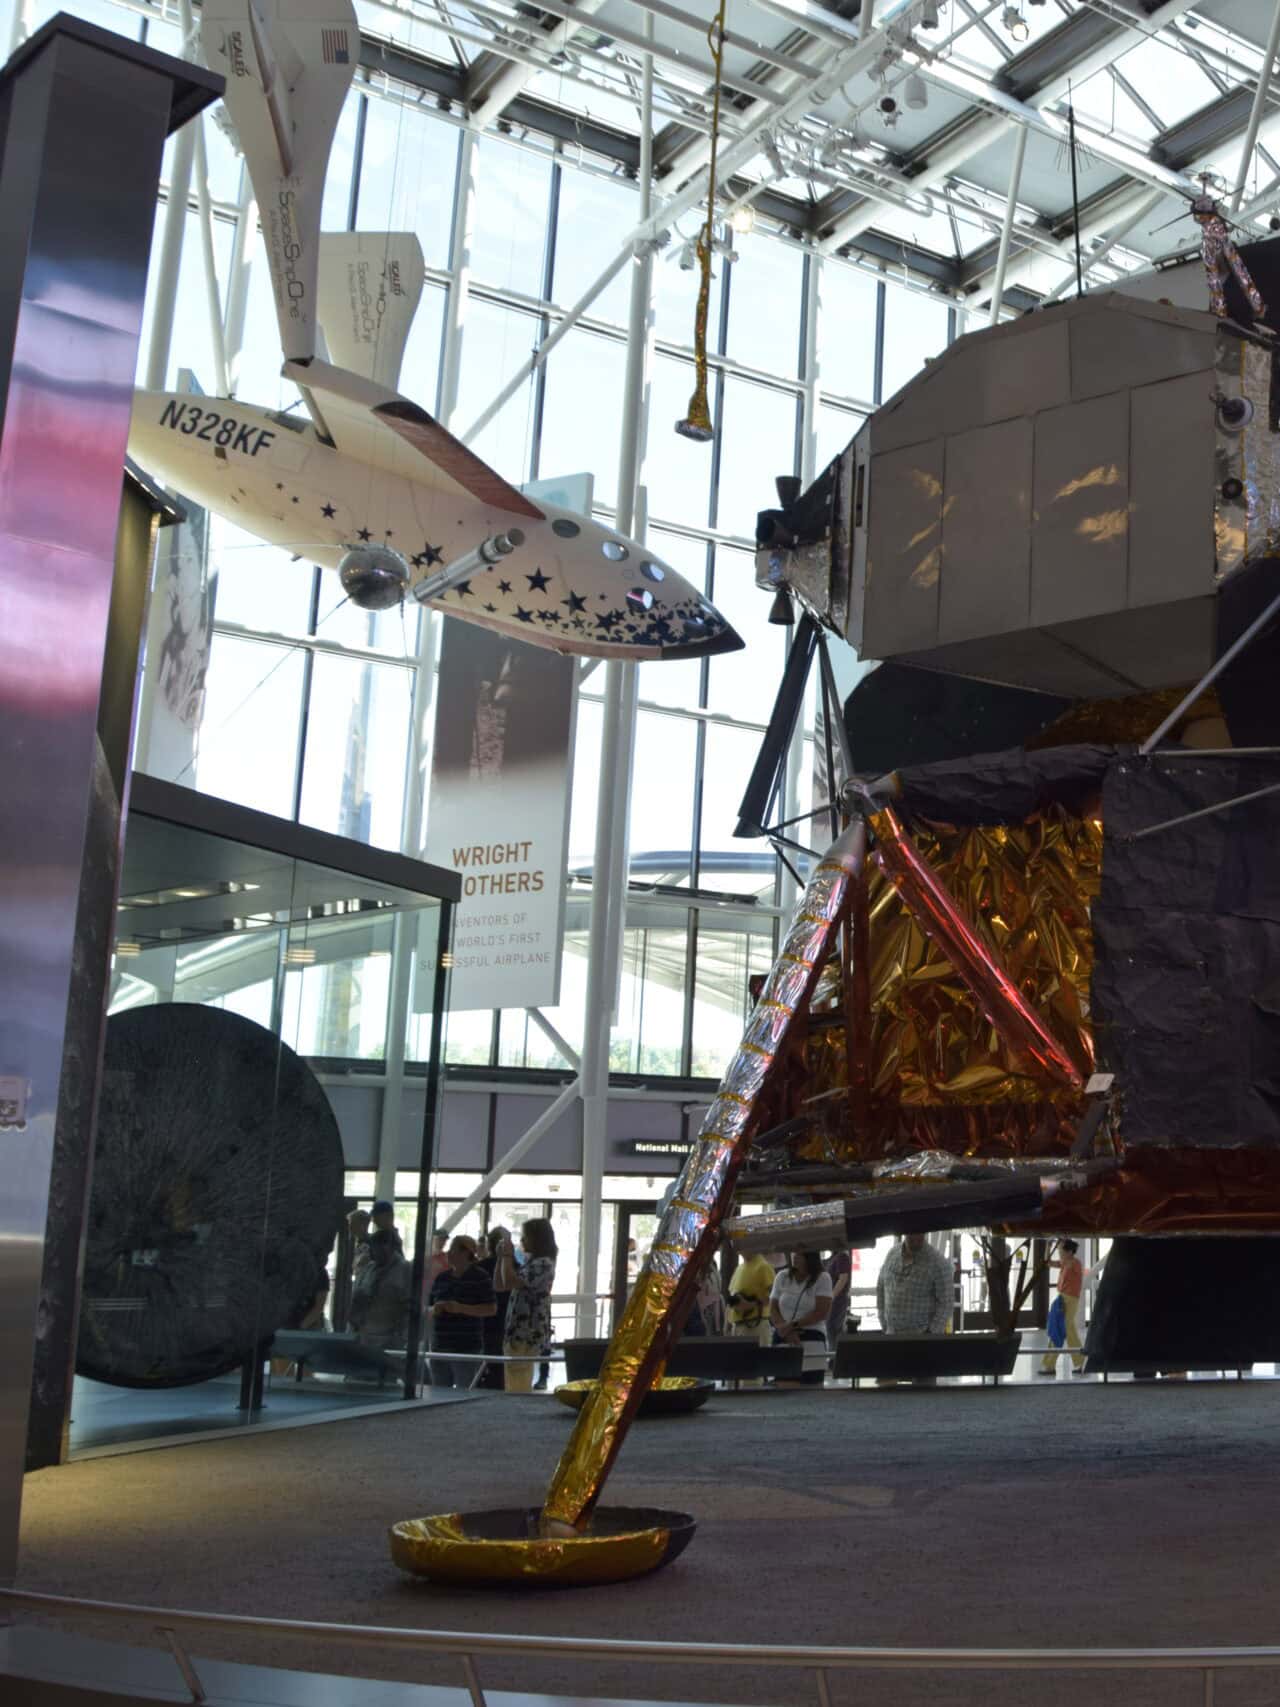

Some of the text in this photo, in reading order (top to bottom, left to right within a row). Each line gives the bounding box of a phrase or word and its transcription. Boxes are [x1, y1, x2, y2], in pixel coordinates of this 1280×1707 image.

[160, 400, 276, 456] N328KF
[452, 841, 533, 868] WRIGHT
[464, 871, 545, 897] OTHERS
[513, 912, 528, 924] OF
[457, 932, 542, 948] WORLD'S FIRST
[494, 952, 551, 966] AIRPLANE
[635, 1143, 669, 1153] National
[671, 1144, 688, 1153] Mall
